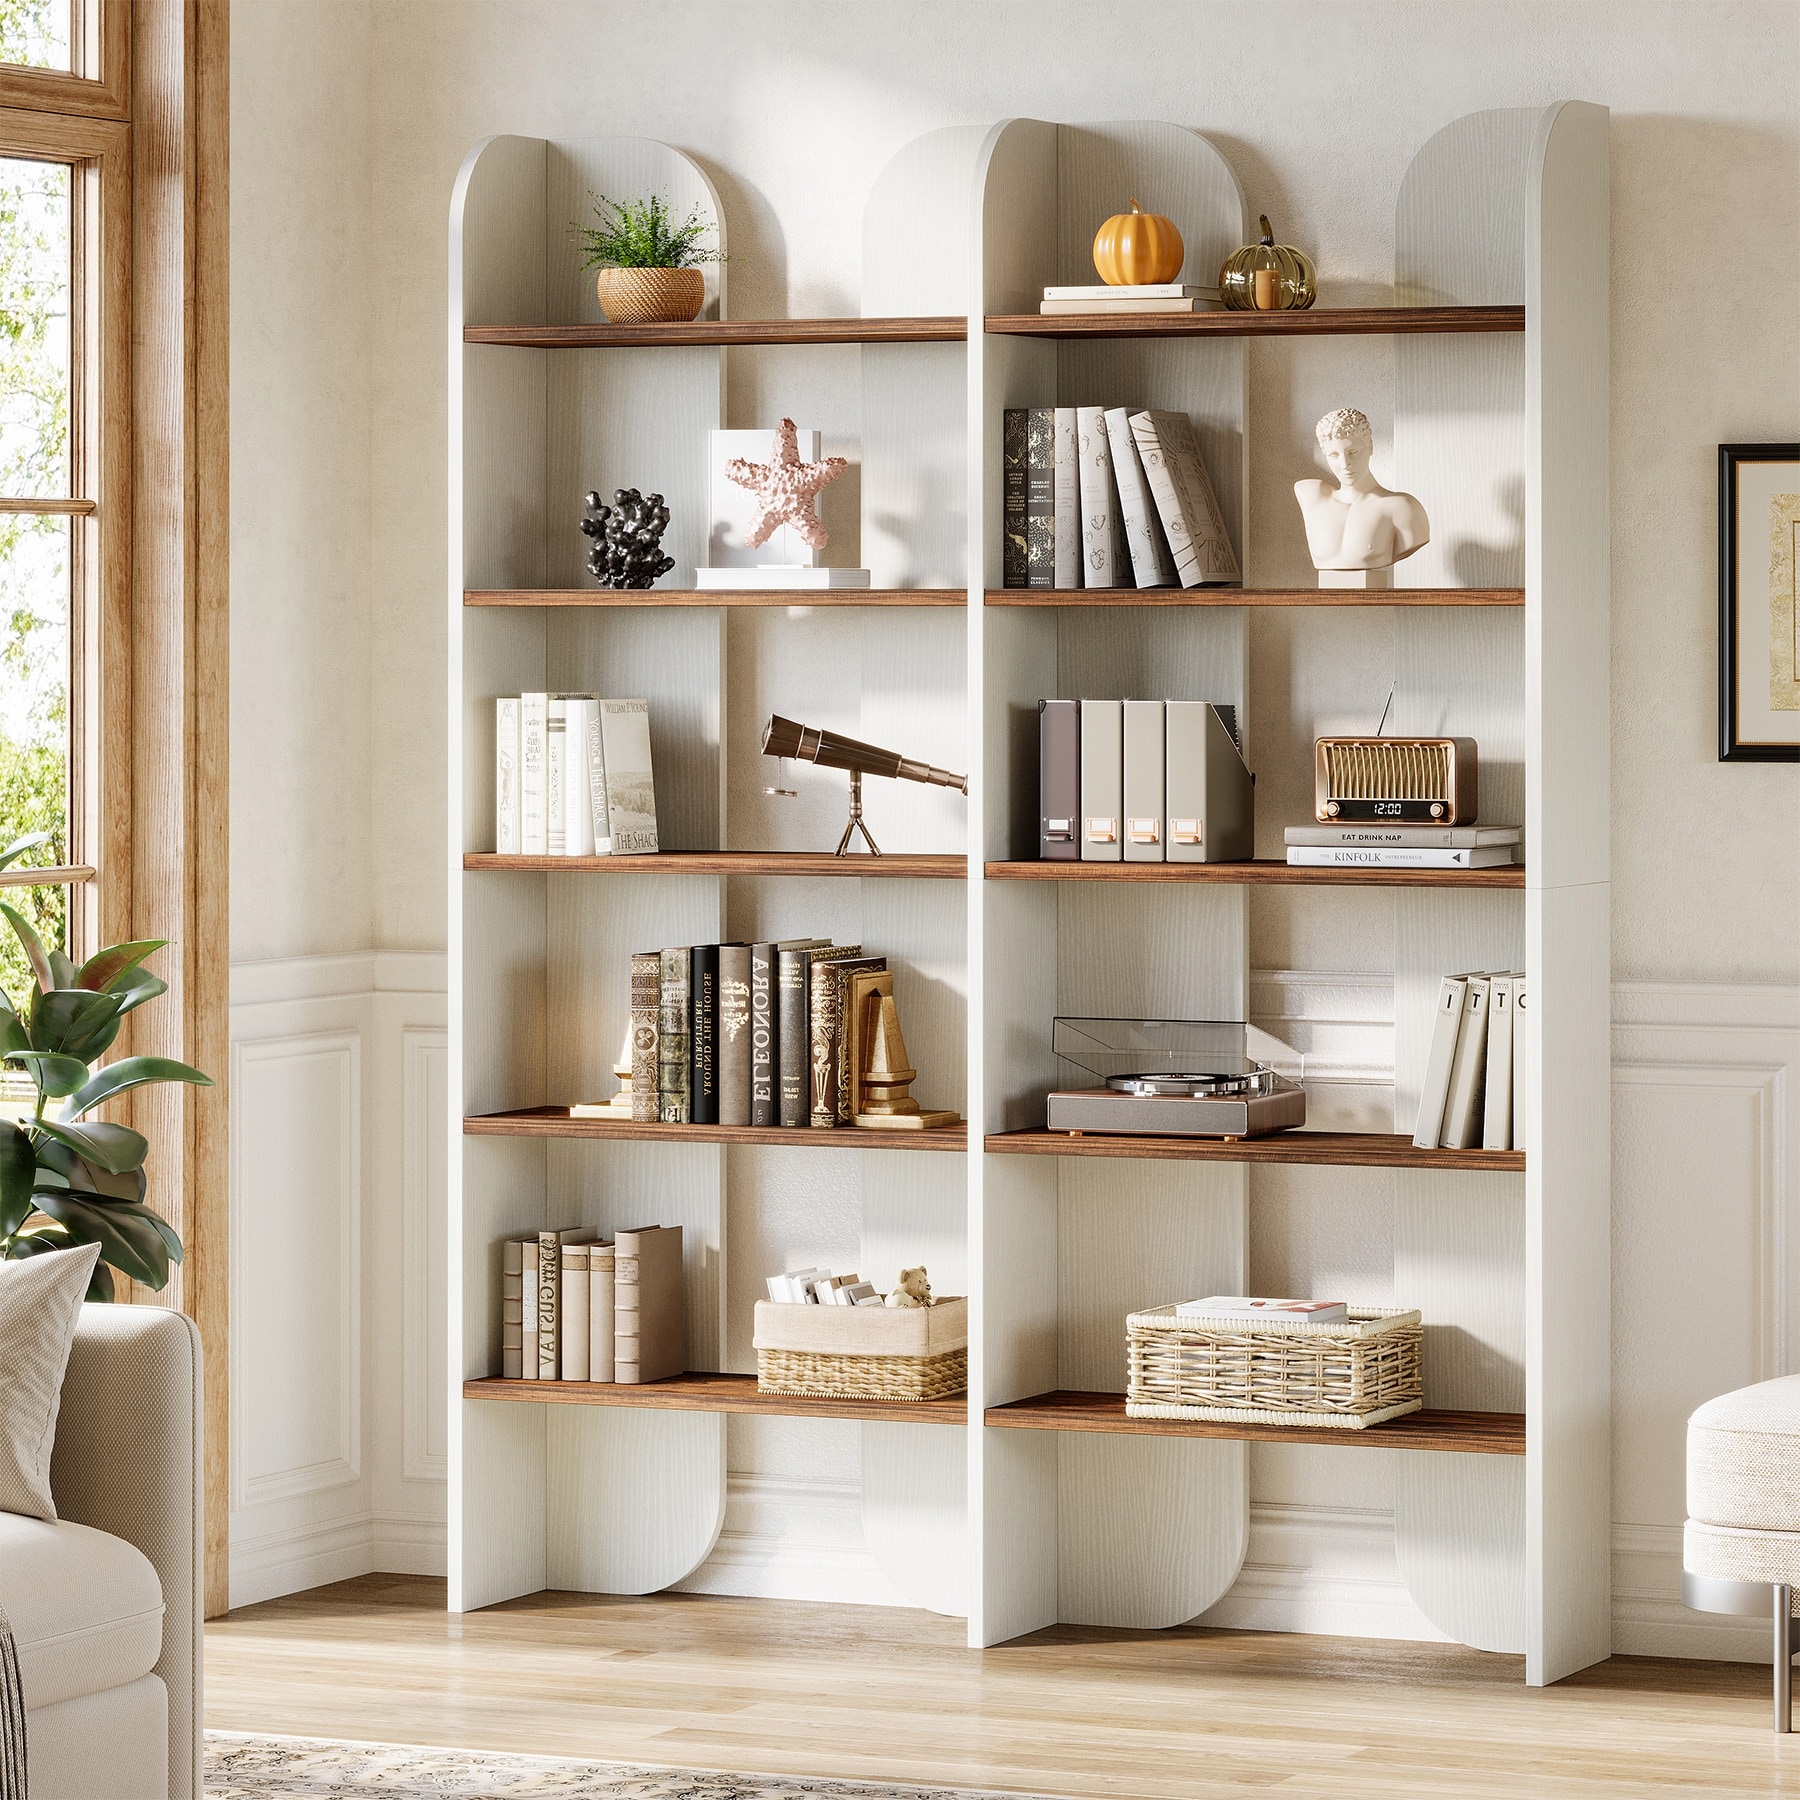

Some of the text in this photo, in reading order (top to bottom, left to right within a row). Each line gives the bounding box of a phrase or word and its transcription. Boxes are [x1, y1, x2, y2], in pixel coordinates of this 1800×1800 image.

[588, 718, 607, 824] YOUNG THE SHACK
[1374, 803, 1402, 815] 12:00
[615, 831, 658, 849] THE SHACK
[1334, 852, 1381, 862] KINFOLK
[1472, 992, 1481, 1008] T
[1497, 992, 1506, 1008] T
